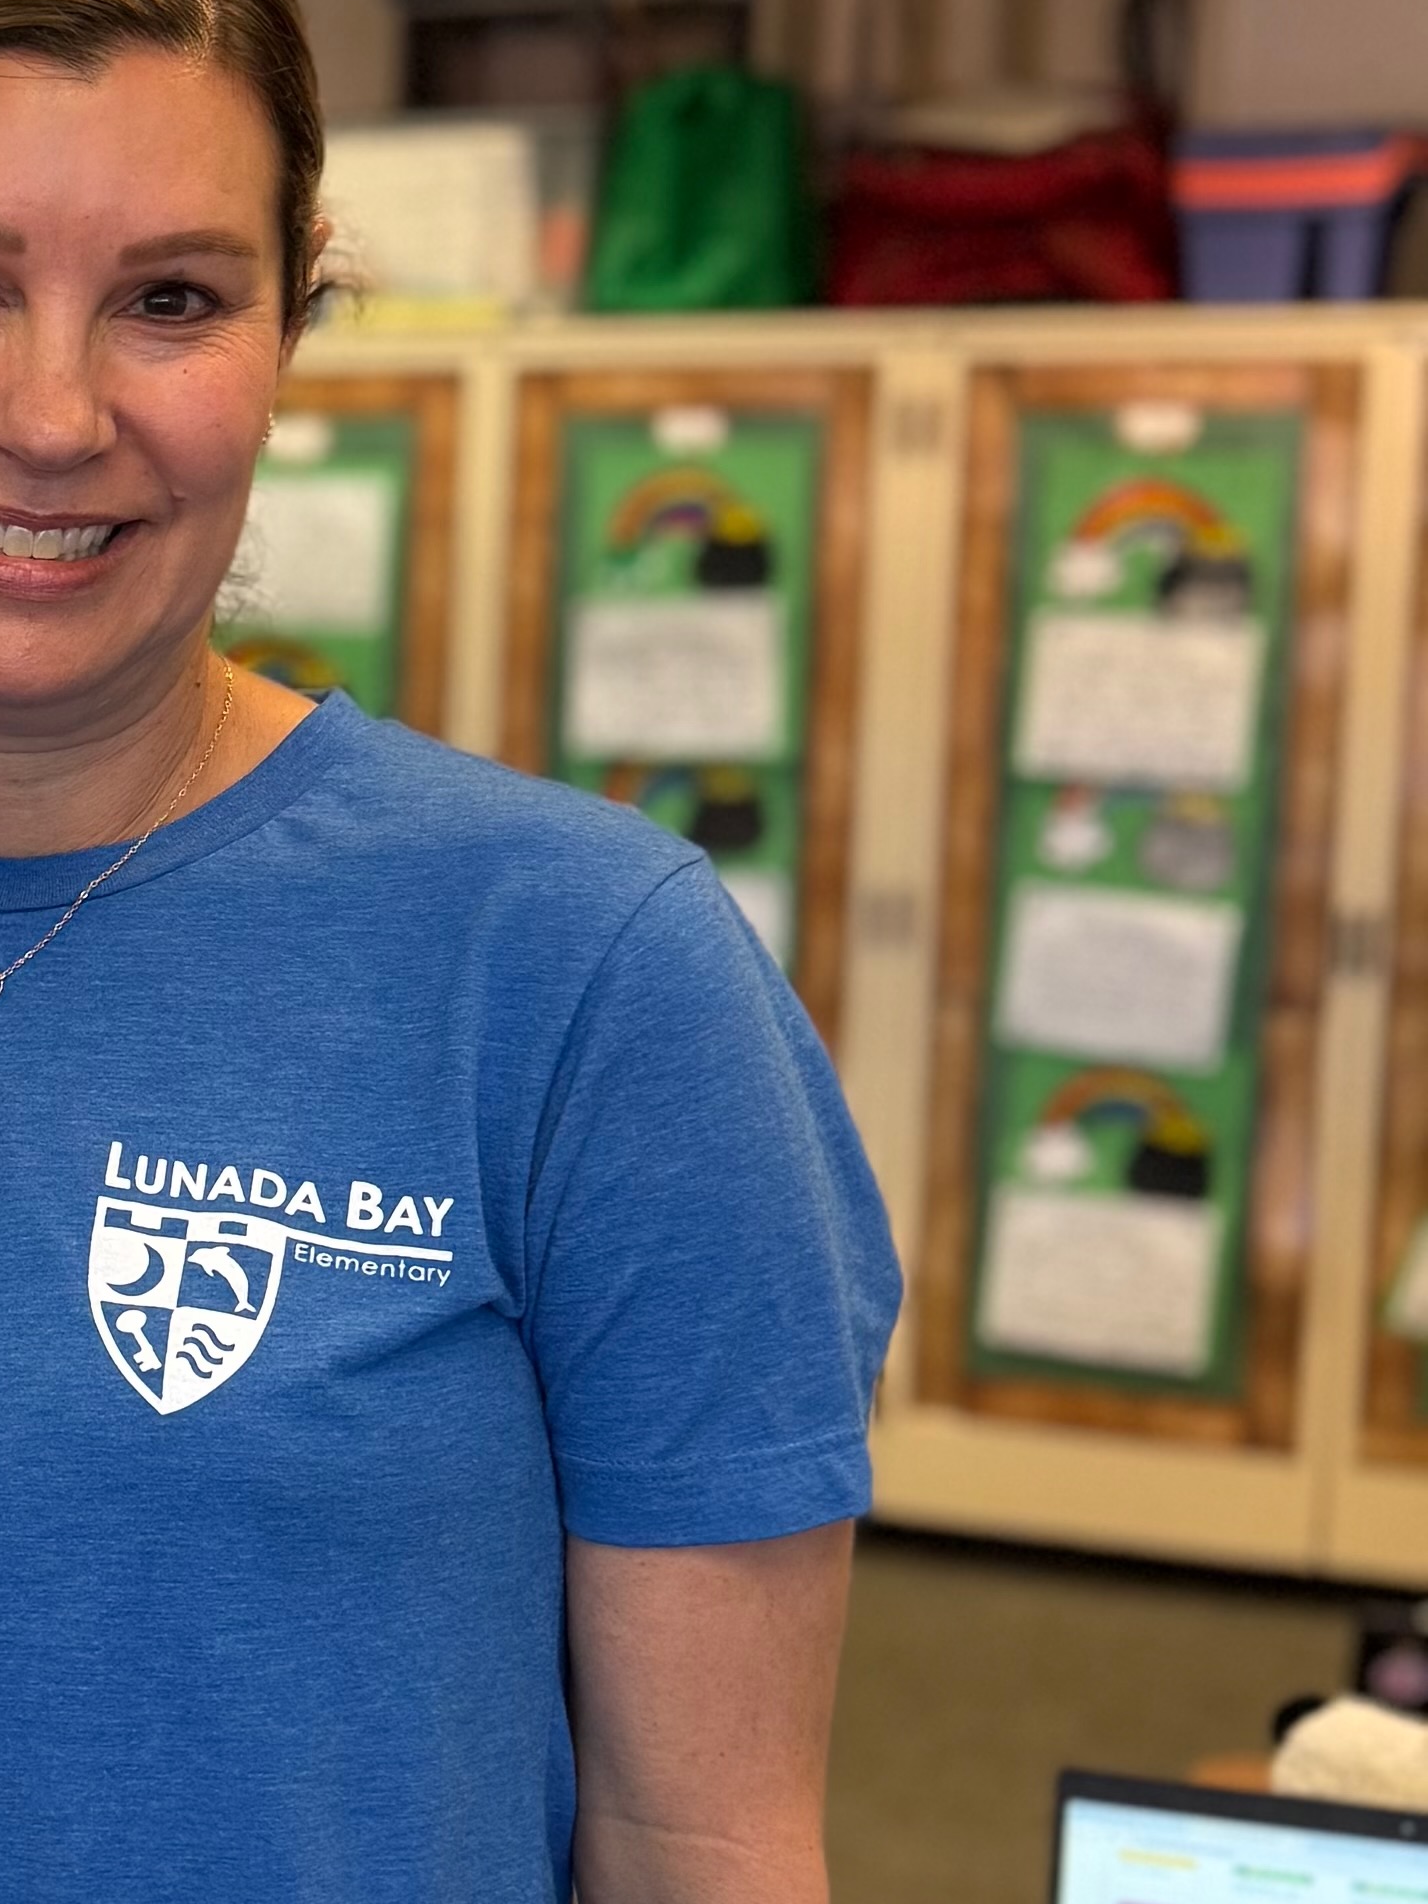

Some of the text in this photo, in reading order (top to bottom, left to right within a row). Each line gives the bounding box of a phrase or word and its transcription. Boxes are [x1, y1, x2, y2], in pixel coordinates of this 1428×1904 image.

[104, 1141, 454, 1237] LUNADA BAY
[293, 1242, 451, 1287] Elementary
